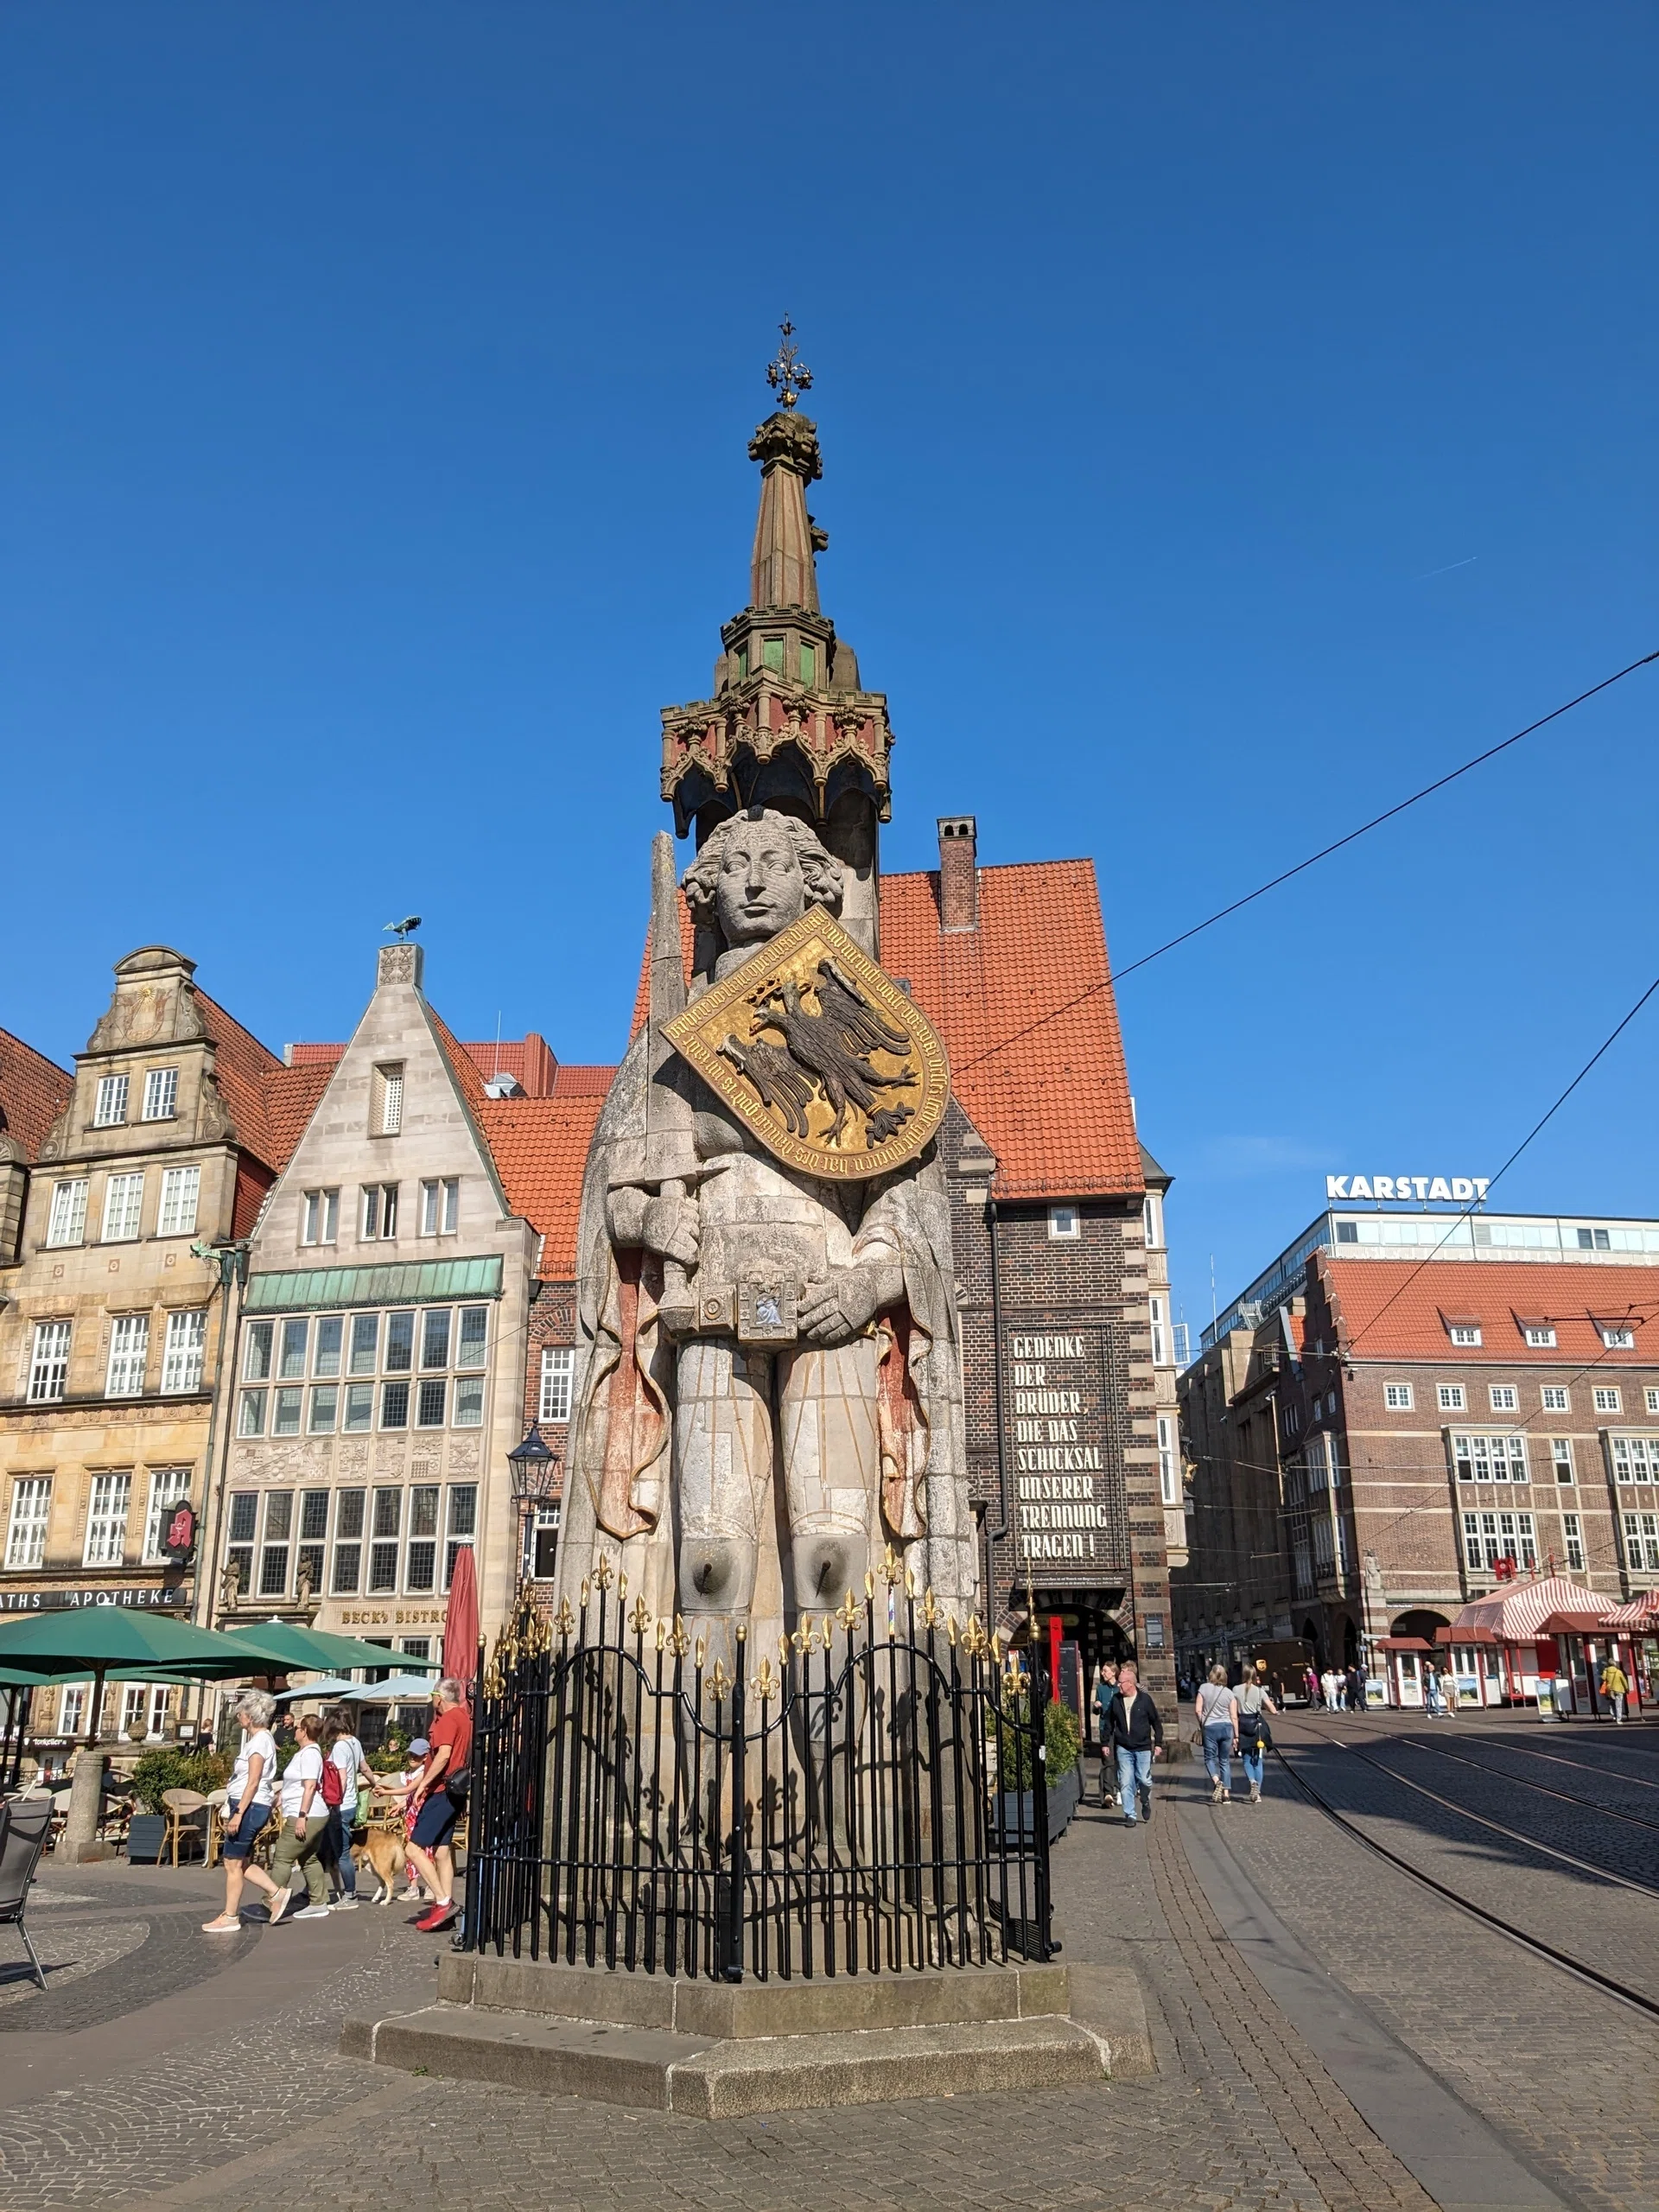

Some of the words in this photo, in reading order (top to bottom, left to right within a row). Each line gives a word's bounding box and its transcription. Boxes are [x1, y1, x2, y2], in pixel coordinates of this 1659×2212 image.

[1325, 1175, 1490, 1200] KARSTADT
[1014, 1336, 1085, 1359] GEDENKE
[1014, 1364, 1046, 1387] DER
[1015, 1388, 1089, 1415] BRÜDER,
[1017, 1420, 1043, 1443] DIE
[1047, 1419, 1077, 1442] DAS
[1018, 1447, 1103, 1471] SCHICKSAL
[1019, 1476, 1094, 1500] UNSERER
[1020, 1504, 1108, 1529] TRENNUNG
[1021, 1534, 1084, 1559] TRAGEN
[70, 1589, 174, 1606] APOTHEKE
